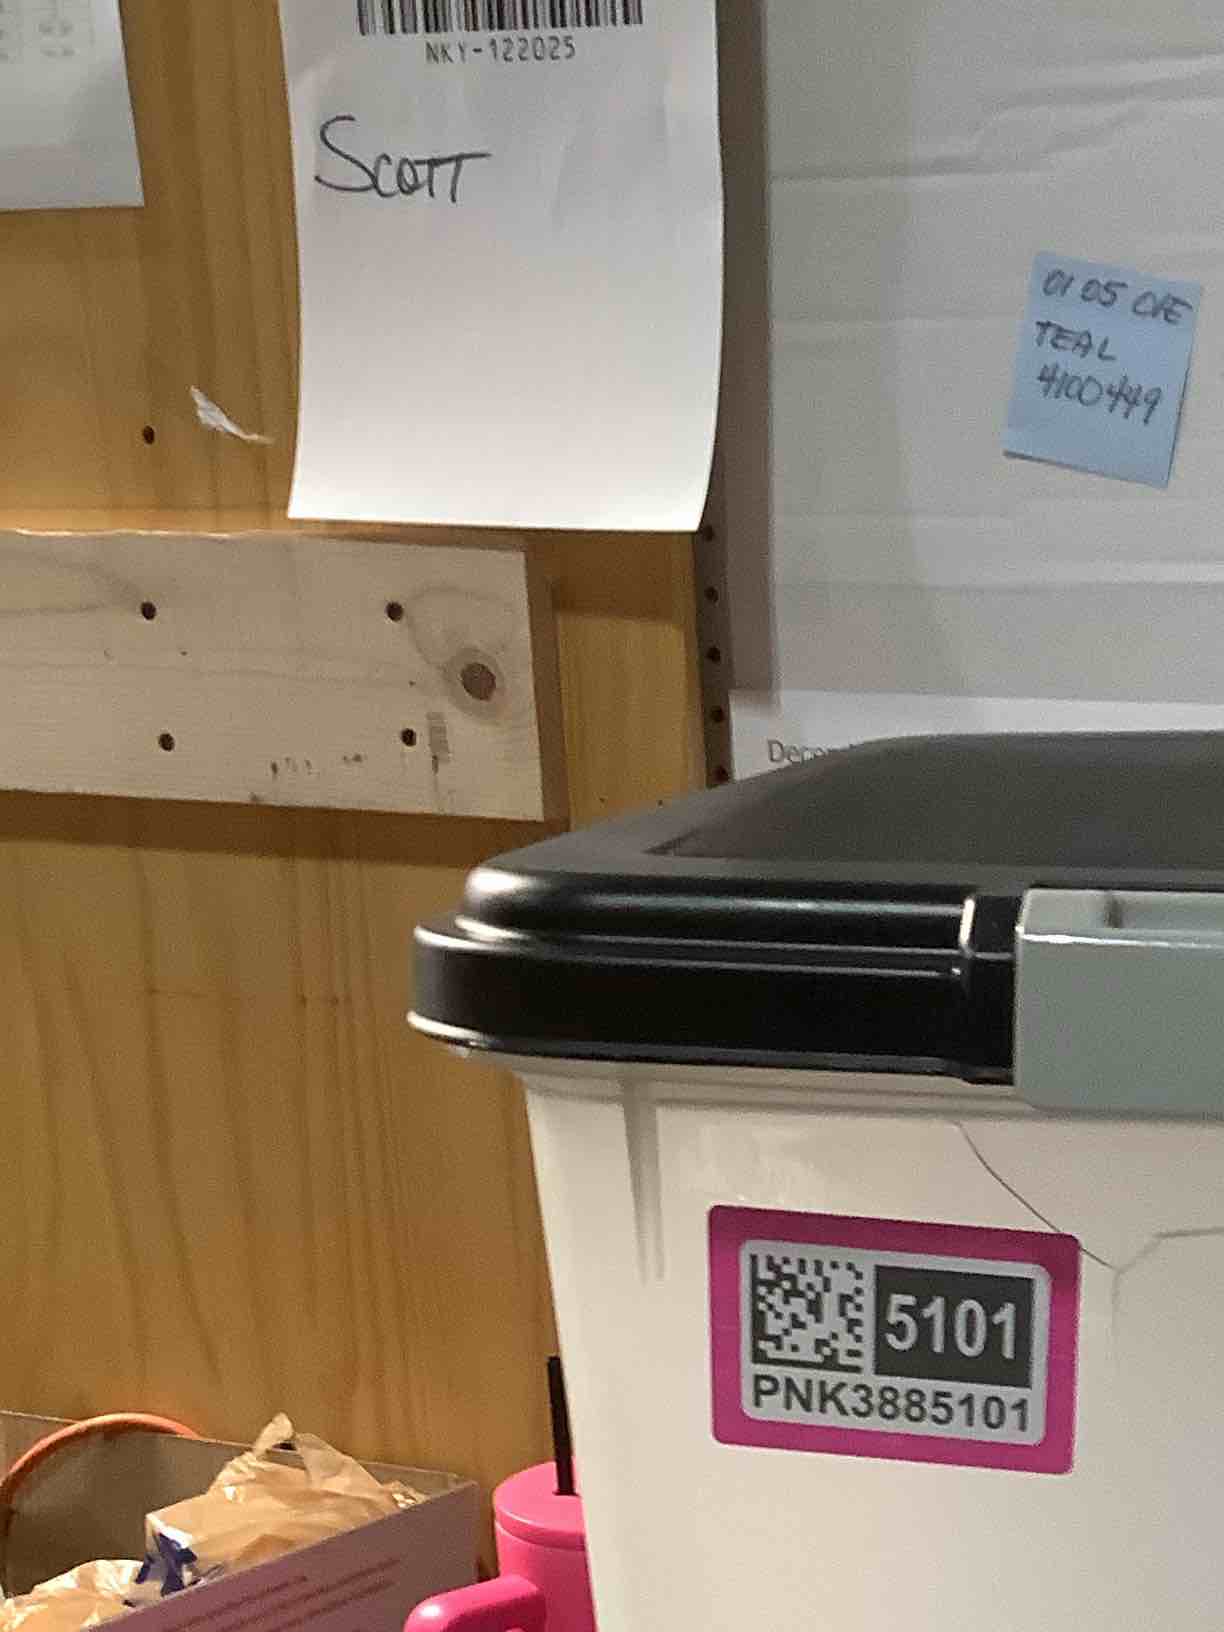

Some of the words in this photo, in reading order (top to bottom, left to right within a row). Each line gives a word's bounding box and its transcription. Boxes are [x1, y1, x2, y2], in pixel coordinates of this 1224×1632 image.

[426, 35, 577, 63] NKY-122025
[1035, 320, 1118, 361] TEAL
[885, 1292, 1017, 1361] 5101
[752, 1372, 1030, 1434] PNK3885101
